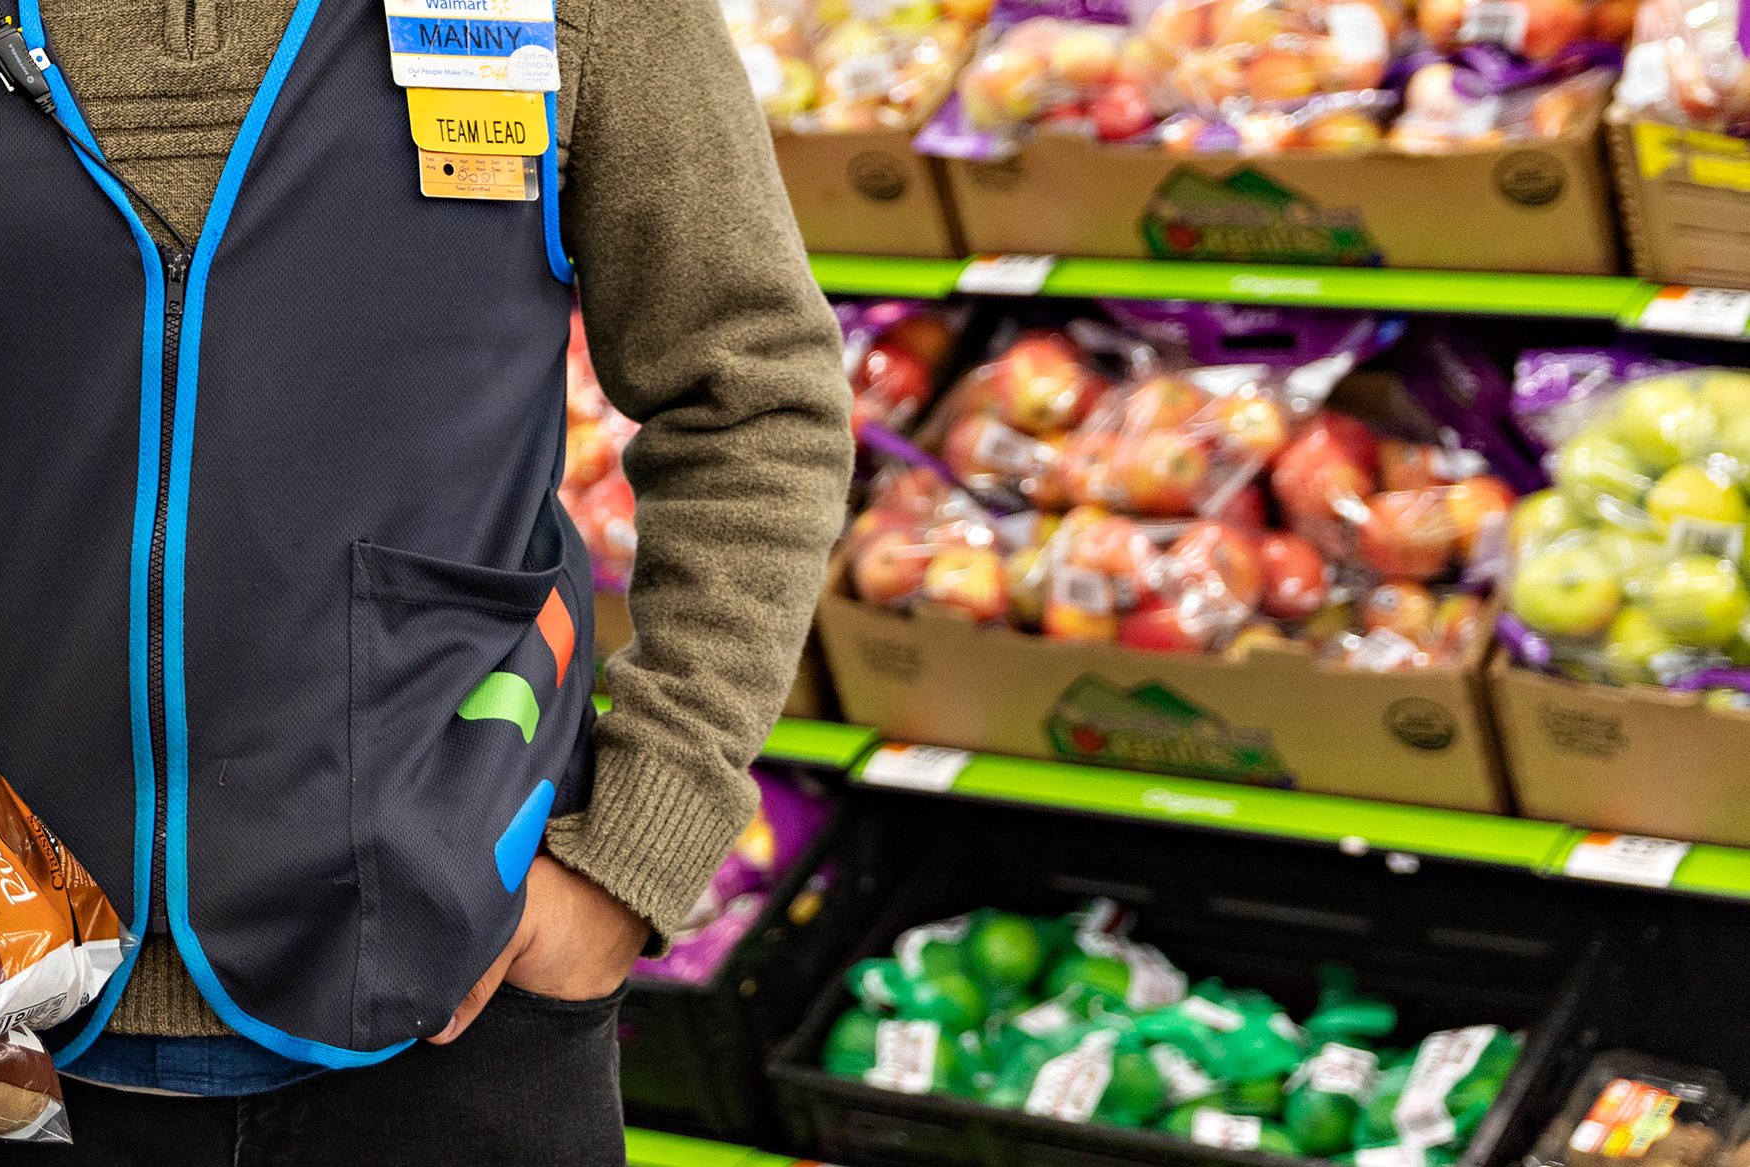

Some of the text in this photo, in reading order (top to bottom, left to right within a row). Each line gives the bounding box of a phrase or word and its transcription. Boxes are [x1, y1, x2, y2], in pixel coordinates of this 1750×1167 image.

[419, 23, 522, 50] MANNY
[436, 118, 526, 144] TEAM LEAD
[27, 814, 64, 891] Classics
